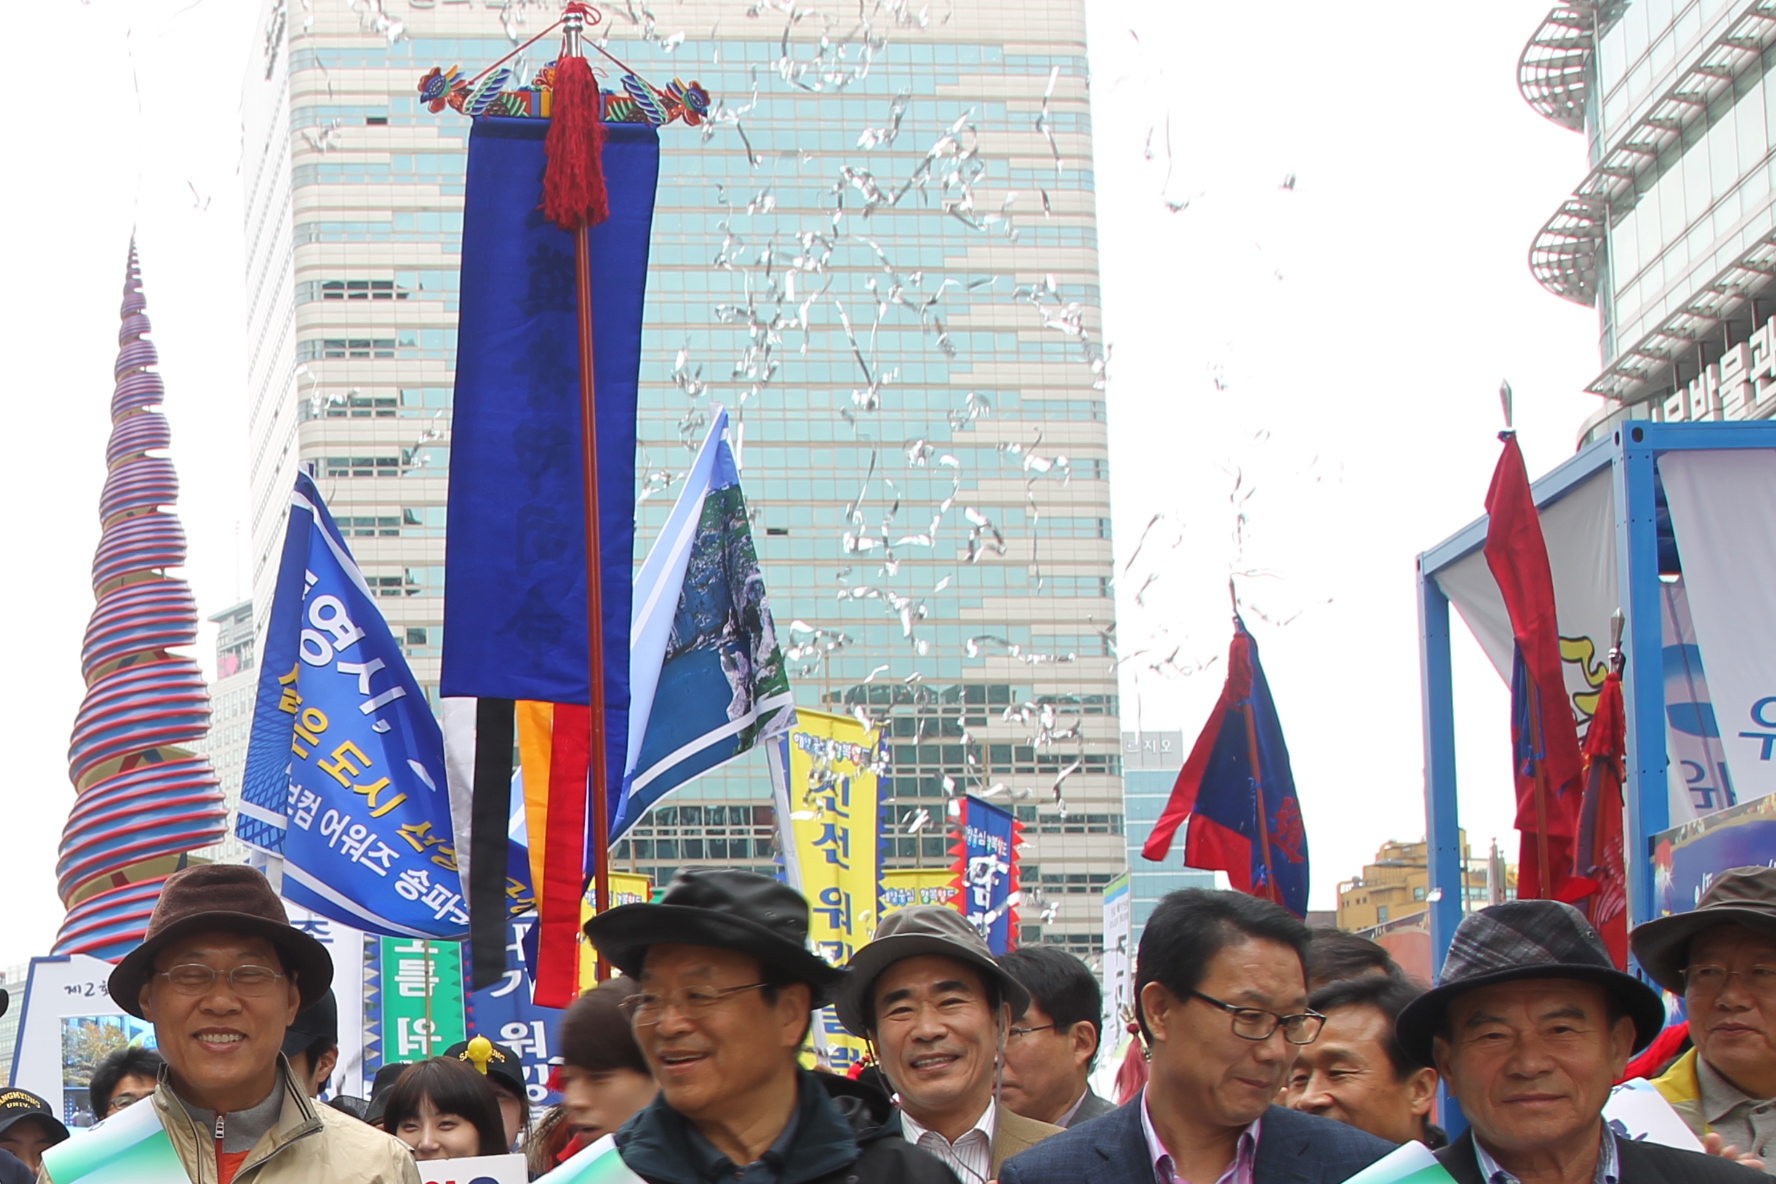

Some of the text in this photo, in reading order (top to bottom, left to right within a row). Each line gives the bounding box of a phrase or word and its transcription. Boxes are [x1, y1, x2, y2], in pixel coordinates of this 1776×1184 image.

[1652, 314, 1776, 422] 박물관
[317, 740, 408, 819] 도시
[319, 807, 401, 878] 어워즈
[6, 1101, 31, 1109] UNIV.
